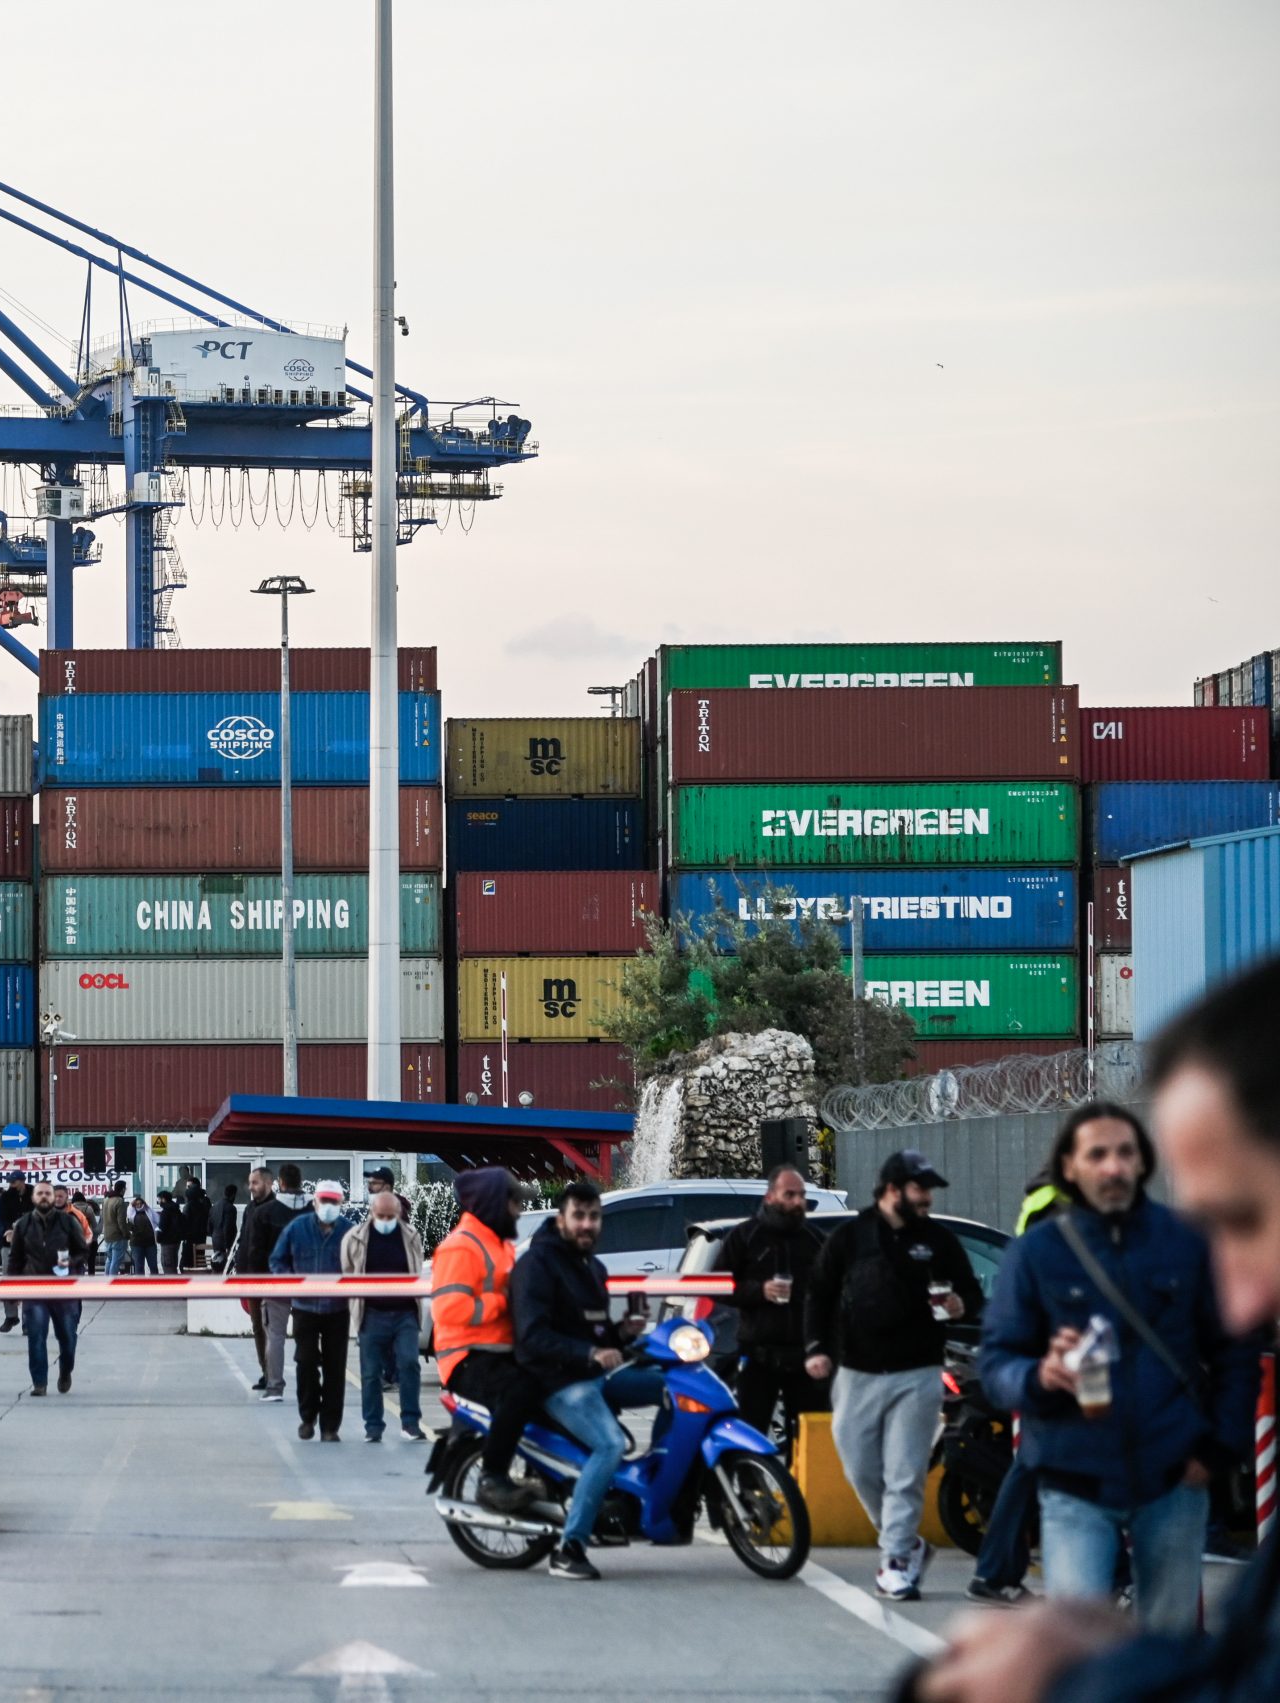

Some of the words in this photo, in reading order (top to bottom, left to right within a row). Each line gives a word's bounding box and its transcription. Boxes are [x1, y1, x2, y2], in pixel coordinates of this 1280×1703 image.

[192, 340, 253, 360] PCT
[283, 365, 315, 373] COSCO
[65, 660, 76, 694] TRIT
[749, 673, 974, 688] EVERGREEN
[207, 728, 274, 741] COSCO
[698, 700, 710, 752] TRITON
[1093, 722, 1123, 740] CAI
[210, 740, 272, 749] SHIPPING
[467, 812, 498, 820] seaco
[762, 809, 989, 836] EVERGREEN
[137, 900, 212, 930] CHINA
[230, 899, 350, 930] SHIPPING
[851, 896, 1012, 919] TRIESTINO
[79, 973, 129, 989] OOCL
[865, 980, 990, 1007] GREEN
